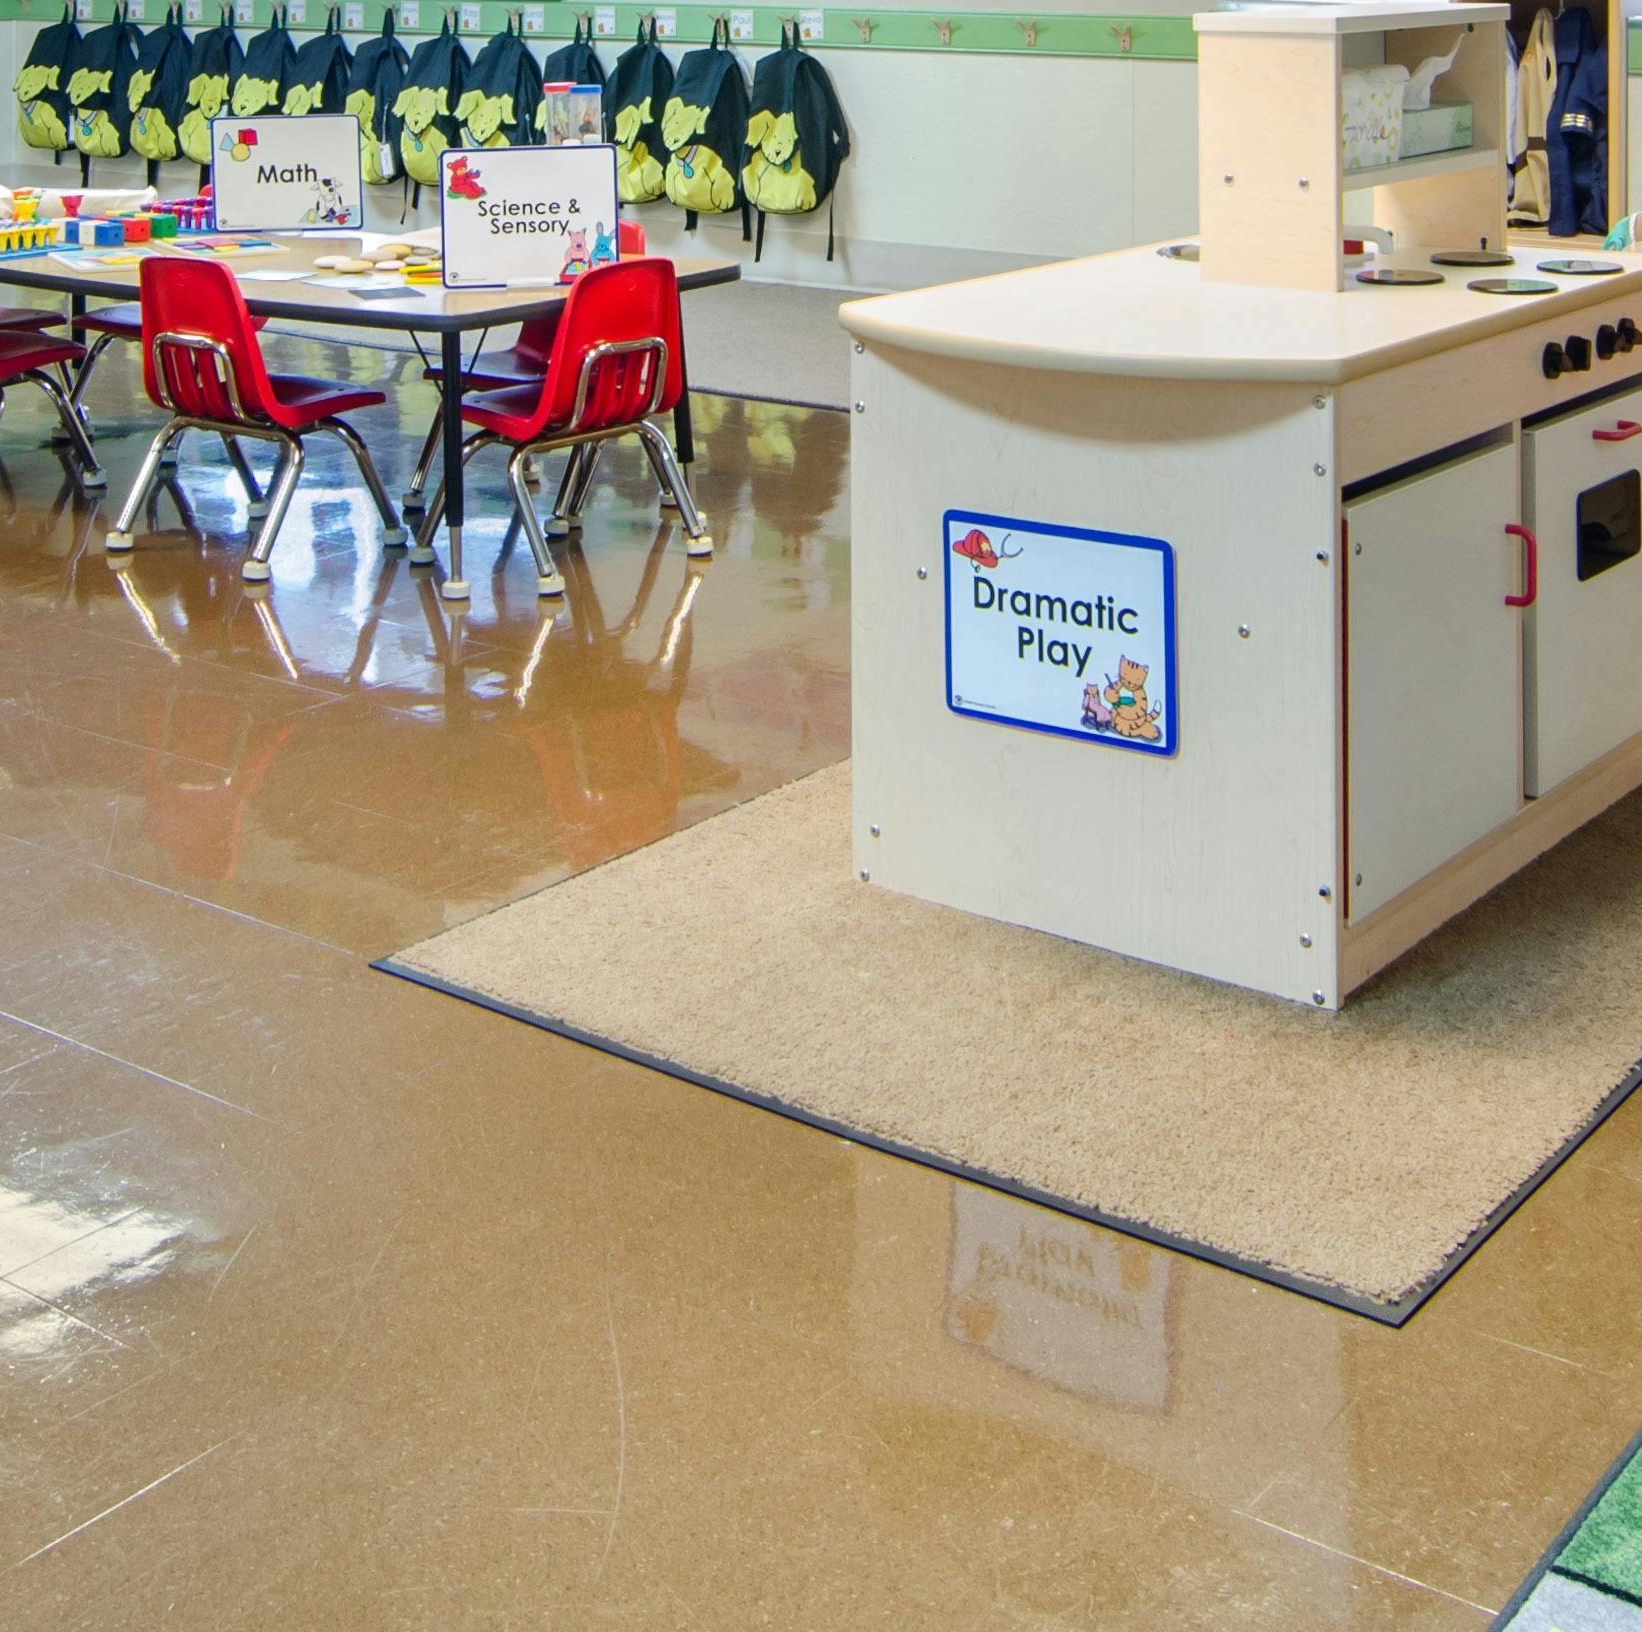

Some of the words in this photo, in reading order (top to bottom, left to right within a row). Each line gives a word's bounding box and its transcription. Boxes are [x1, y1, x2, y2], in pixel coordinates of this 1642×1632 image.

[257, 163, 318, 184] Math
[477, 199, 561, 217] Science
[568, 198, 581, 214] &
[490, 218, 570, 236] Sensory
[972, 575, 1140, 635] Dramatic
[1017, 625, 1093, 678] Play
